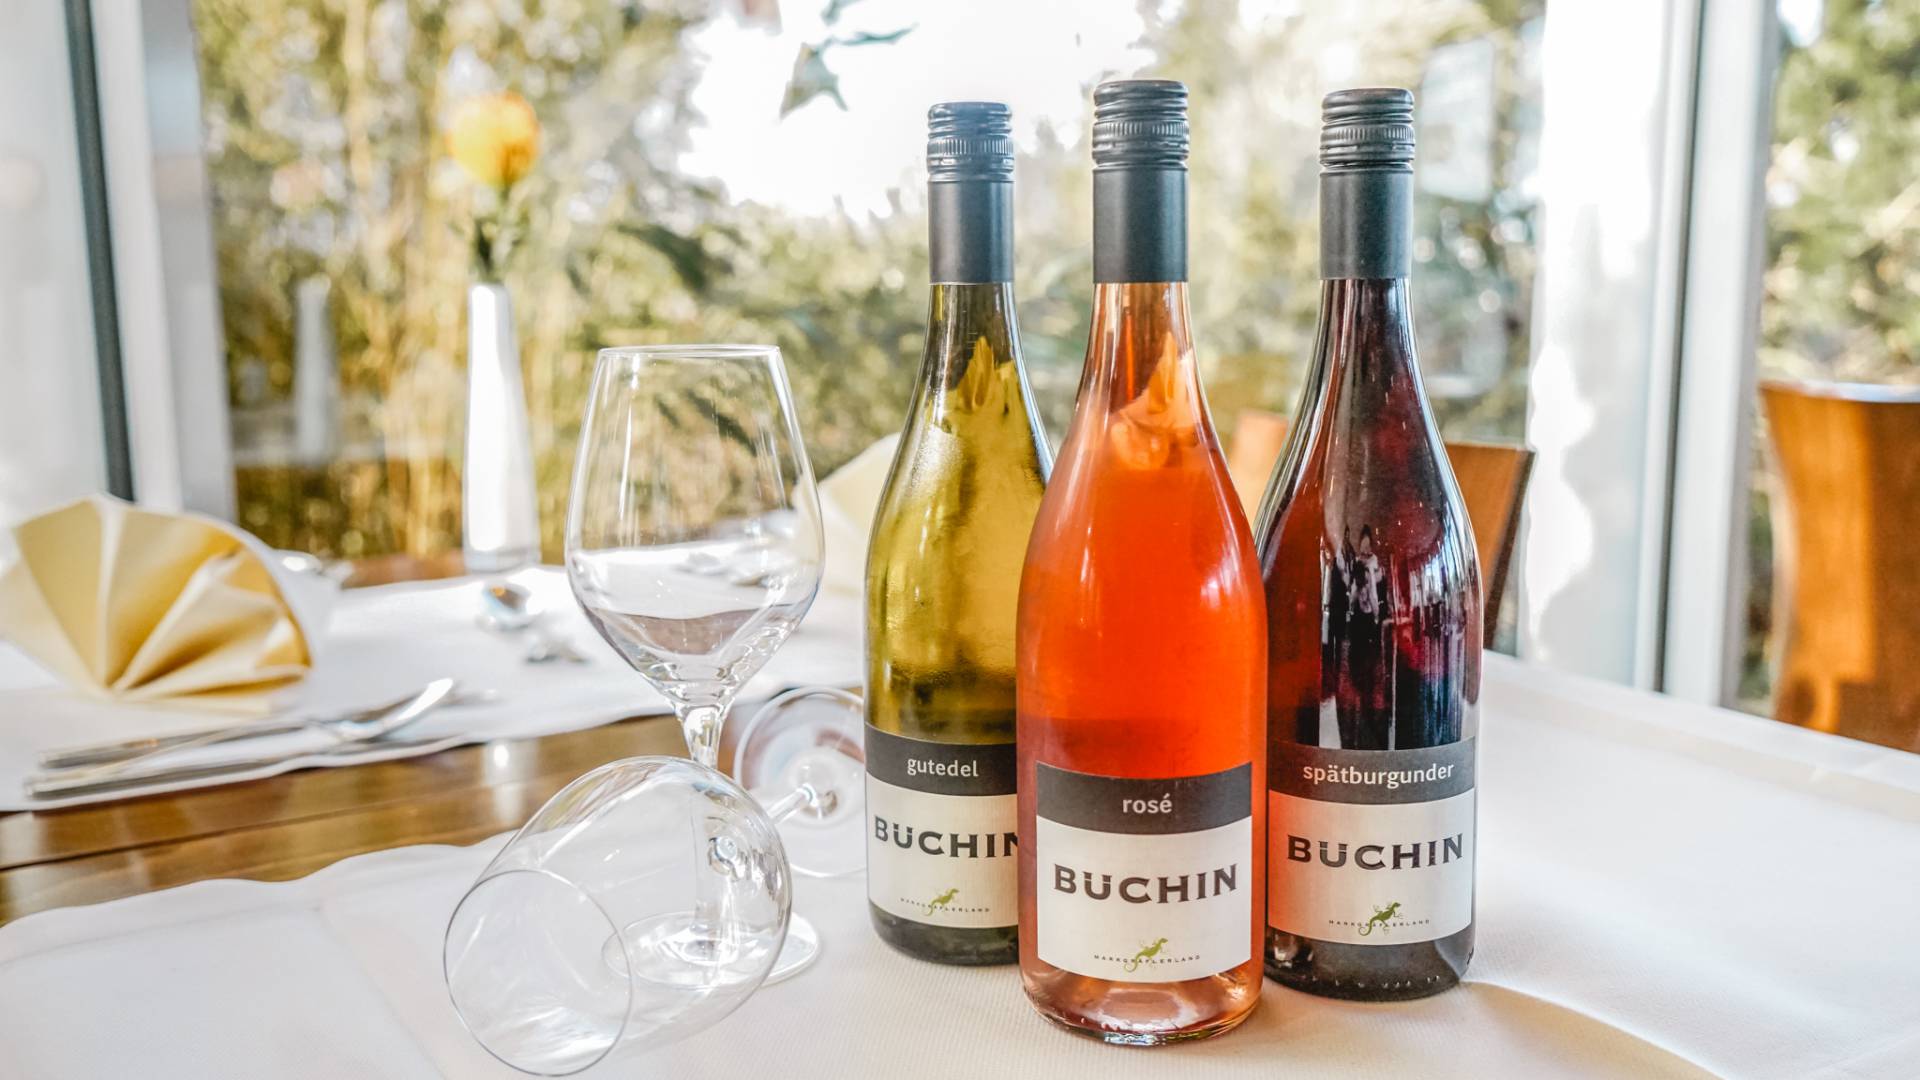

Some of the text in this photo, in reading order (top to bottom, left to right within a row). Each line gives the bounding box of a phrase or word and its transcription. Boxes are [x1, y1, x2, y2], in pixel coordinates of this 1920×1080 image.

[907, 758, 979, 777] gutedel
[1303, 763, 1454, 789] spätburgunder
[1122, 793, 1173, 814] rosé
[1287, 833, 1463, 870] BÜCHIN
[1053, 863, 1238, 904] BÜCHIN
